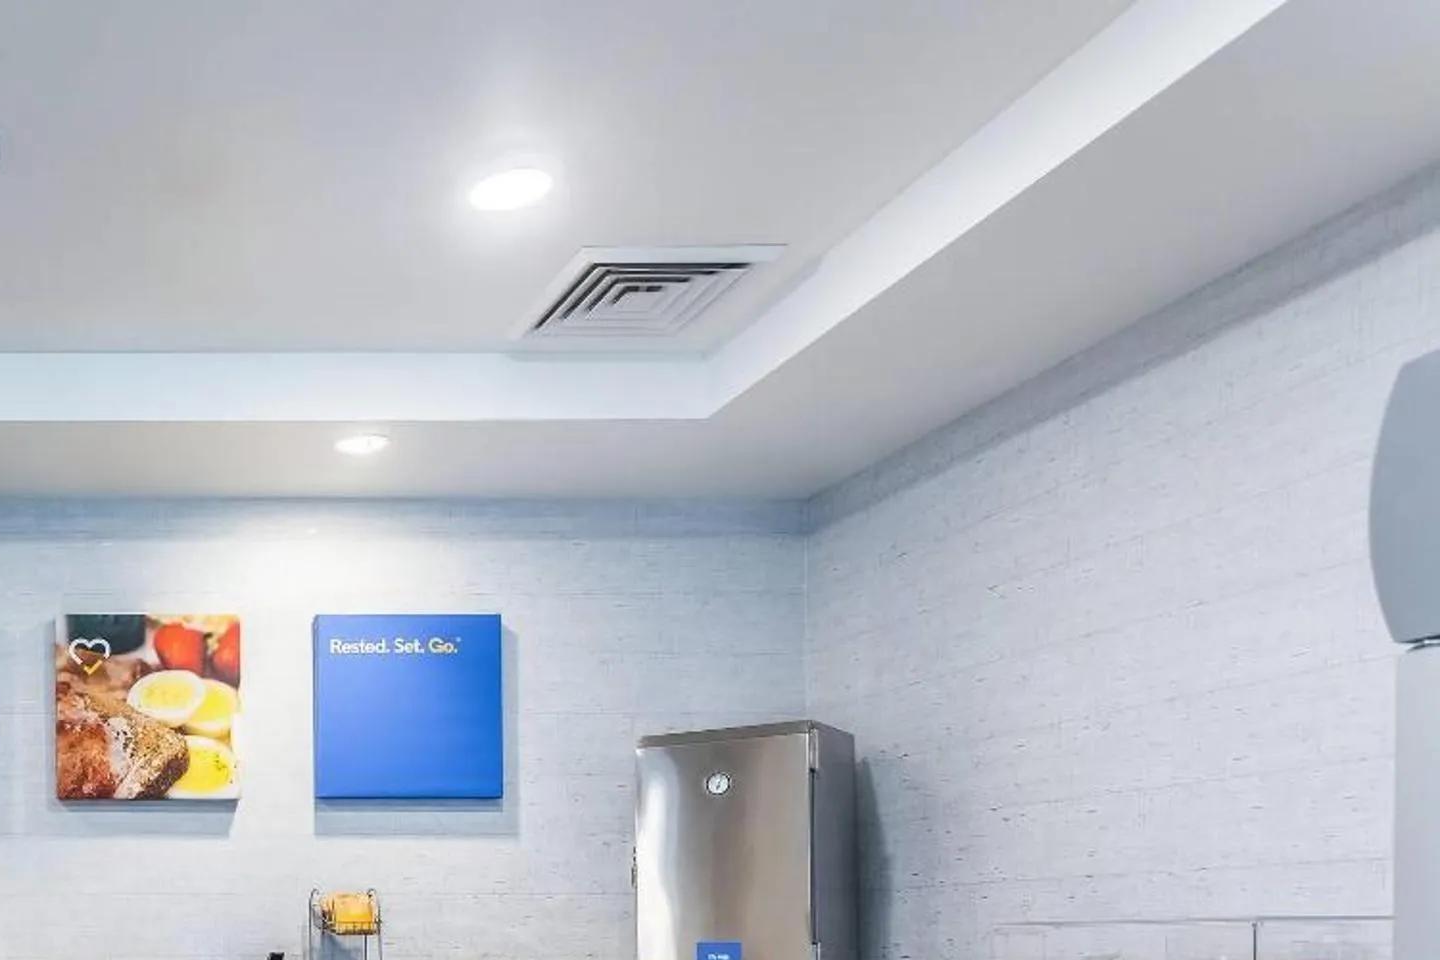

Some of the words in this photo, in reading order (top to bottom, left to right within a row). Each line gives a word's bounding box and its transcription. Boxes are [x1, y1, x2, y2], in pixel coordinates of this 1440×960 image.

[329, 638, 390, 654] Rested.
[394, 637, 425, 654] Set.
[428, 637, 458, 654] Go.
